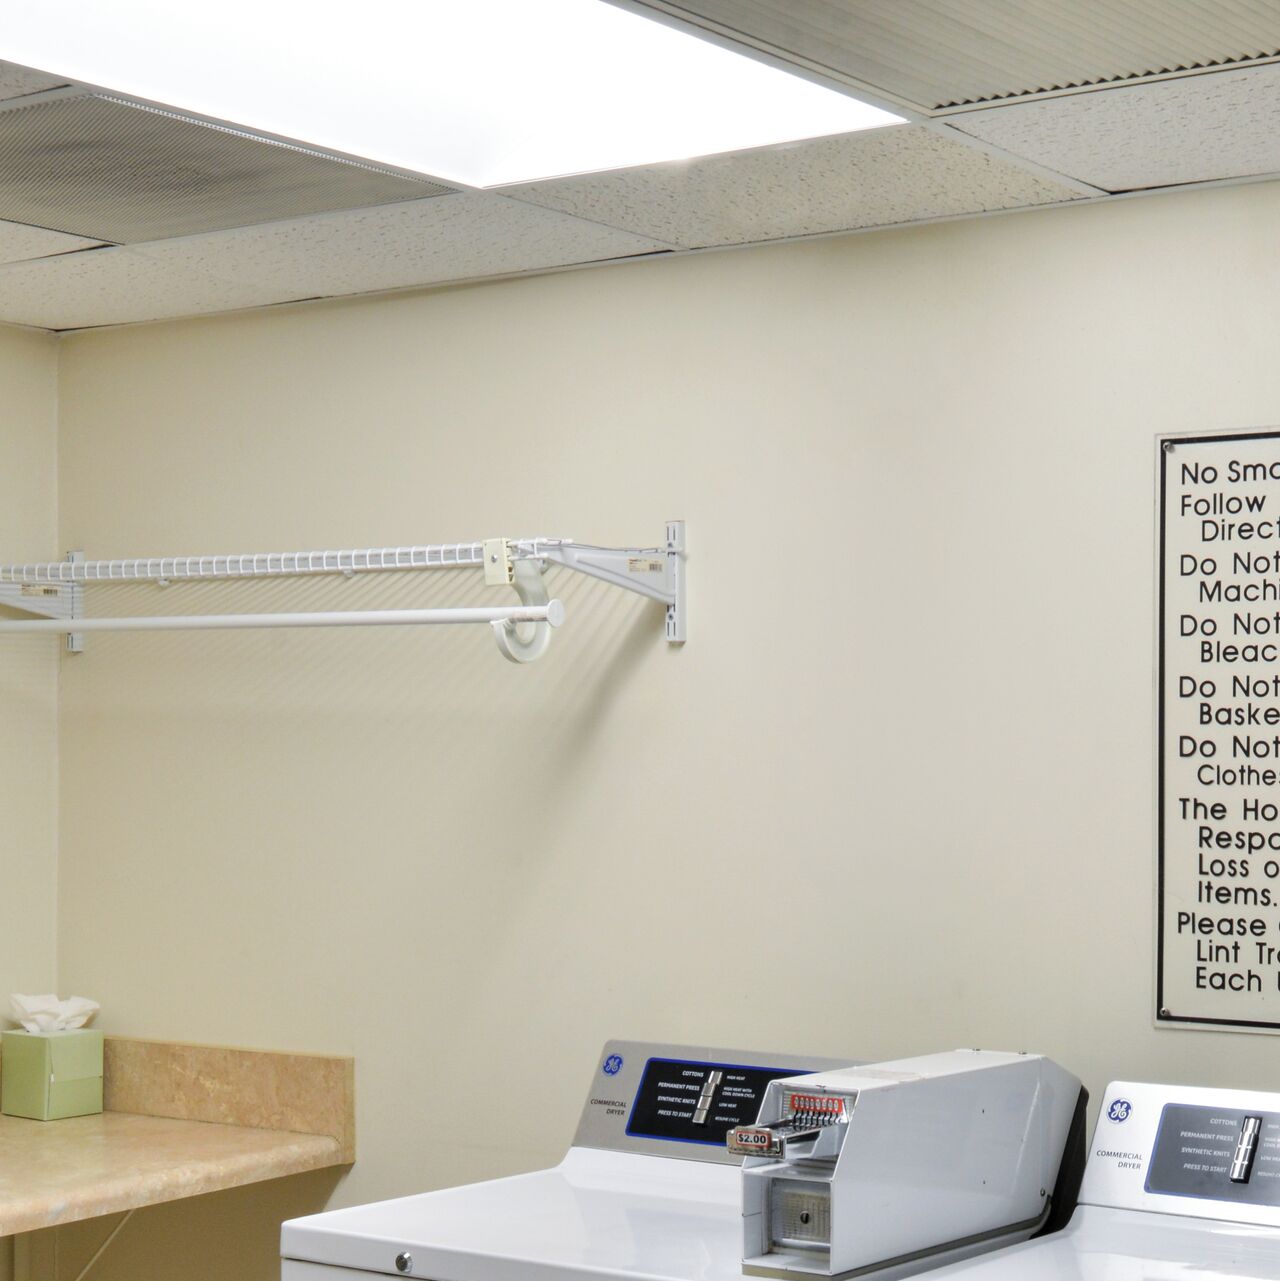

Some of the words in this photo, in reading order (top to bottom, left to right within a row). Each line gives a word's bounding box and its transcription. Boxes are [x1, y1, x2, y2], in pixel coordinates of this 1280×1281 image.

[1182, 463, 1217, 485] No
[1182, 493, 1266, 516] Follow
[1181, 555, 1216, 576] Do
[1234, 551, 1280, 574] Not
[1181, 615, 1217, 636] Do
[1234, 612, 1280, 635] Not
[1180, 676, 1216, 698] Do
[1233, 675, 1280, 697] Not
[1180, 736, 1216, 757] Do
[1233, 736, 1280, 758] Not
[1179, 798, 1227, 820] The
[1199, 853, 1249, 877] Loss
[1199, 881, 1277, 906] Items.
[1178, 912, 1266, 936] Please
[1197, 940, 1240, 963] Lint
[1196, 966, 1261, 992] Each
[657, 1081, 686, 1089] PERMANENT
[682, 1070, 704, 1078] COTTONS
[590, 1098, 627, 1108] COMMERCIAL
[1107, 1099, 1133, 1122] GE
[1210, 1117, 1237, 1126] COTTONS
[738, 1134, 766, 1144] $2.00
[1180, 1131, 1216, 1140] PERMANENT
[1216, 1134, 1234, 1142] PRESS
[1096, 1149, 1142, 1160] COMMERCIAL
[1181, 1146, 1213, 1156] SYNTHETIC
[1213, 1149, 1230, 1157] KNITS
[1117, 1160, 1141, 1169] DRYER
[1183, 1162, 1201, 1170] PRESS
[1210, 1165, 1227, 1173] START
